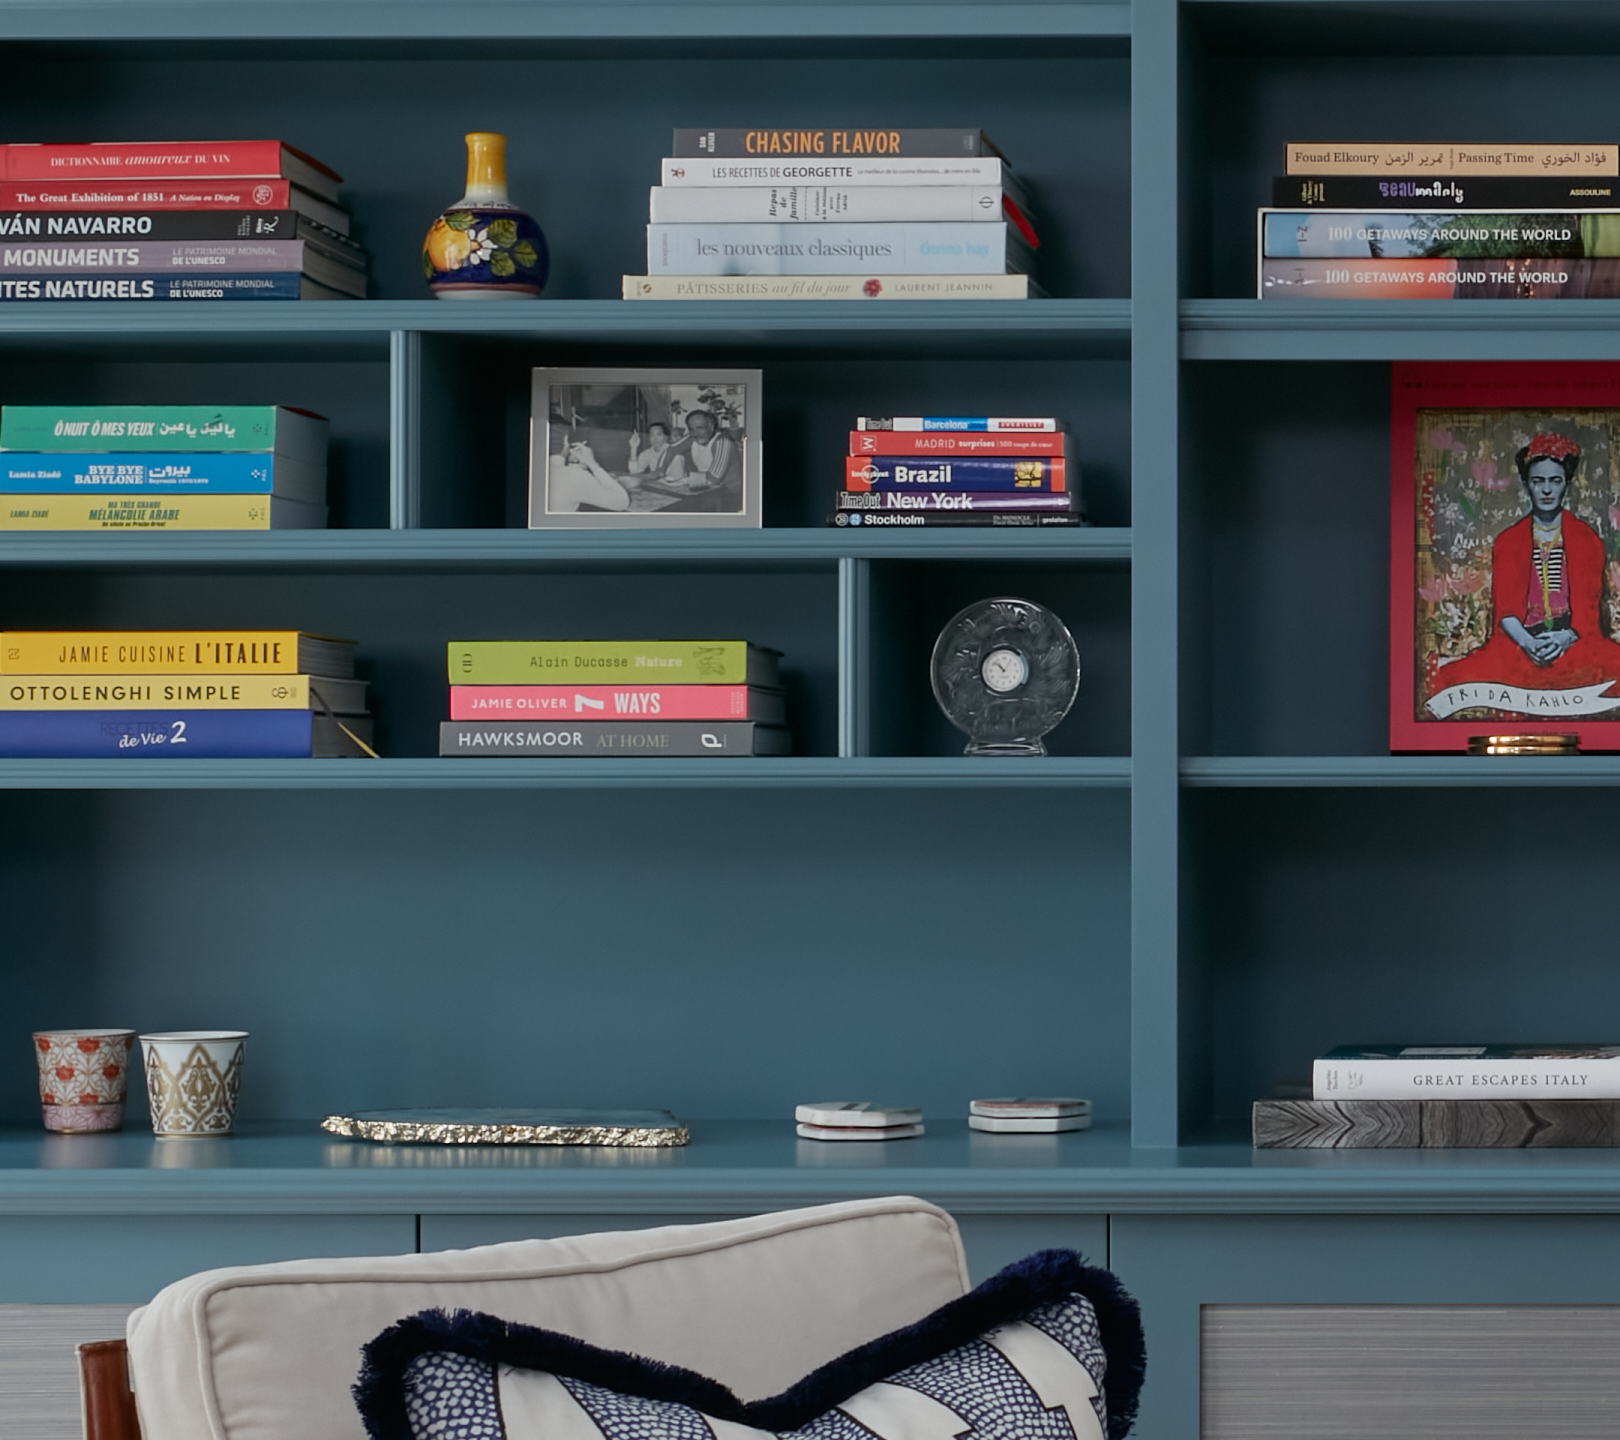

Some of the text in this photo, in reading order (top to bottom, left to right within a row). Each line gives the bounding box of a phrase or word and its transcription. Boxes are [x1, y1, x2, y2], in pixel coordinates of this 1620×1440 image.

[746, 132, 900, 154] CHASING FLAVOR
[1295, 152, 1379, 165] Fouad Elkoury
[1459, 153, 1501, 165] Passing
[1504, 153, 1534, 163] Time
[16, 192, 164, 203] The Great Exhibition of 1851
[48, 217, 152, 235] NAVARRO
[1328, 228, 1571, 241] 100 GETAWAYS AROUND THE WORLD
[696, 239, 892, 260] les nouveaux classiques
[3, 249, 139, 266] MONUMENTS
[45, 281, 154, 299] NATURELS
[89, 466, 143, 475] BYE BYE
[895, 465, 951, 483] Brazil
[75, 475, 143, 484] BABYLONE
[887, 493, 972, 508] New York
[864, 514, 924, 525] Stockholm
[59, 643, 281, 664] JAMIE CUISINE L'ITALIE
[11, 686, 241, 700] OTTOLENGHI SIMPLE
[1448, 689, 1583, 708] FRIDA KAHLO
[472, 699, 512, 709] JAMIE
[517, 699, 567, 708] OLIVER
[614, 693, 660, 713] WAYS
[459, 732, 669, 747] HAWKSMOOR AT HOME
[1413, 1075, 1589, 1086] GREAT ESCAPES ITALY
